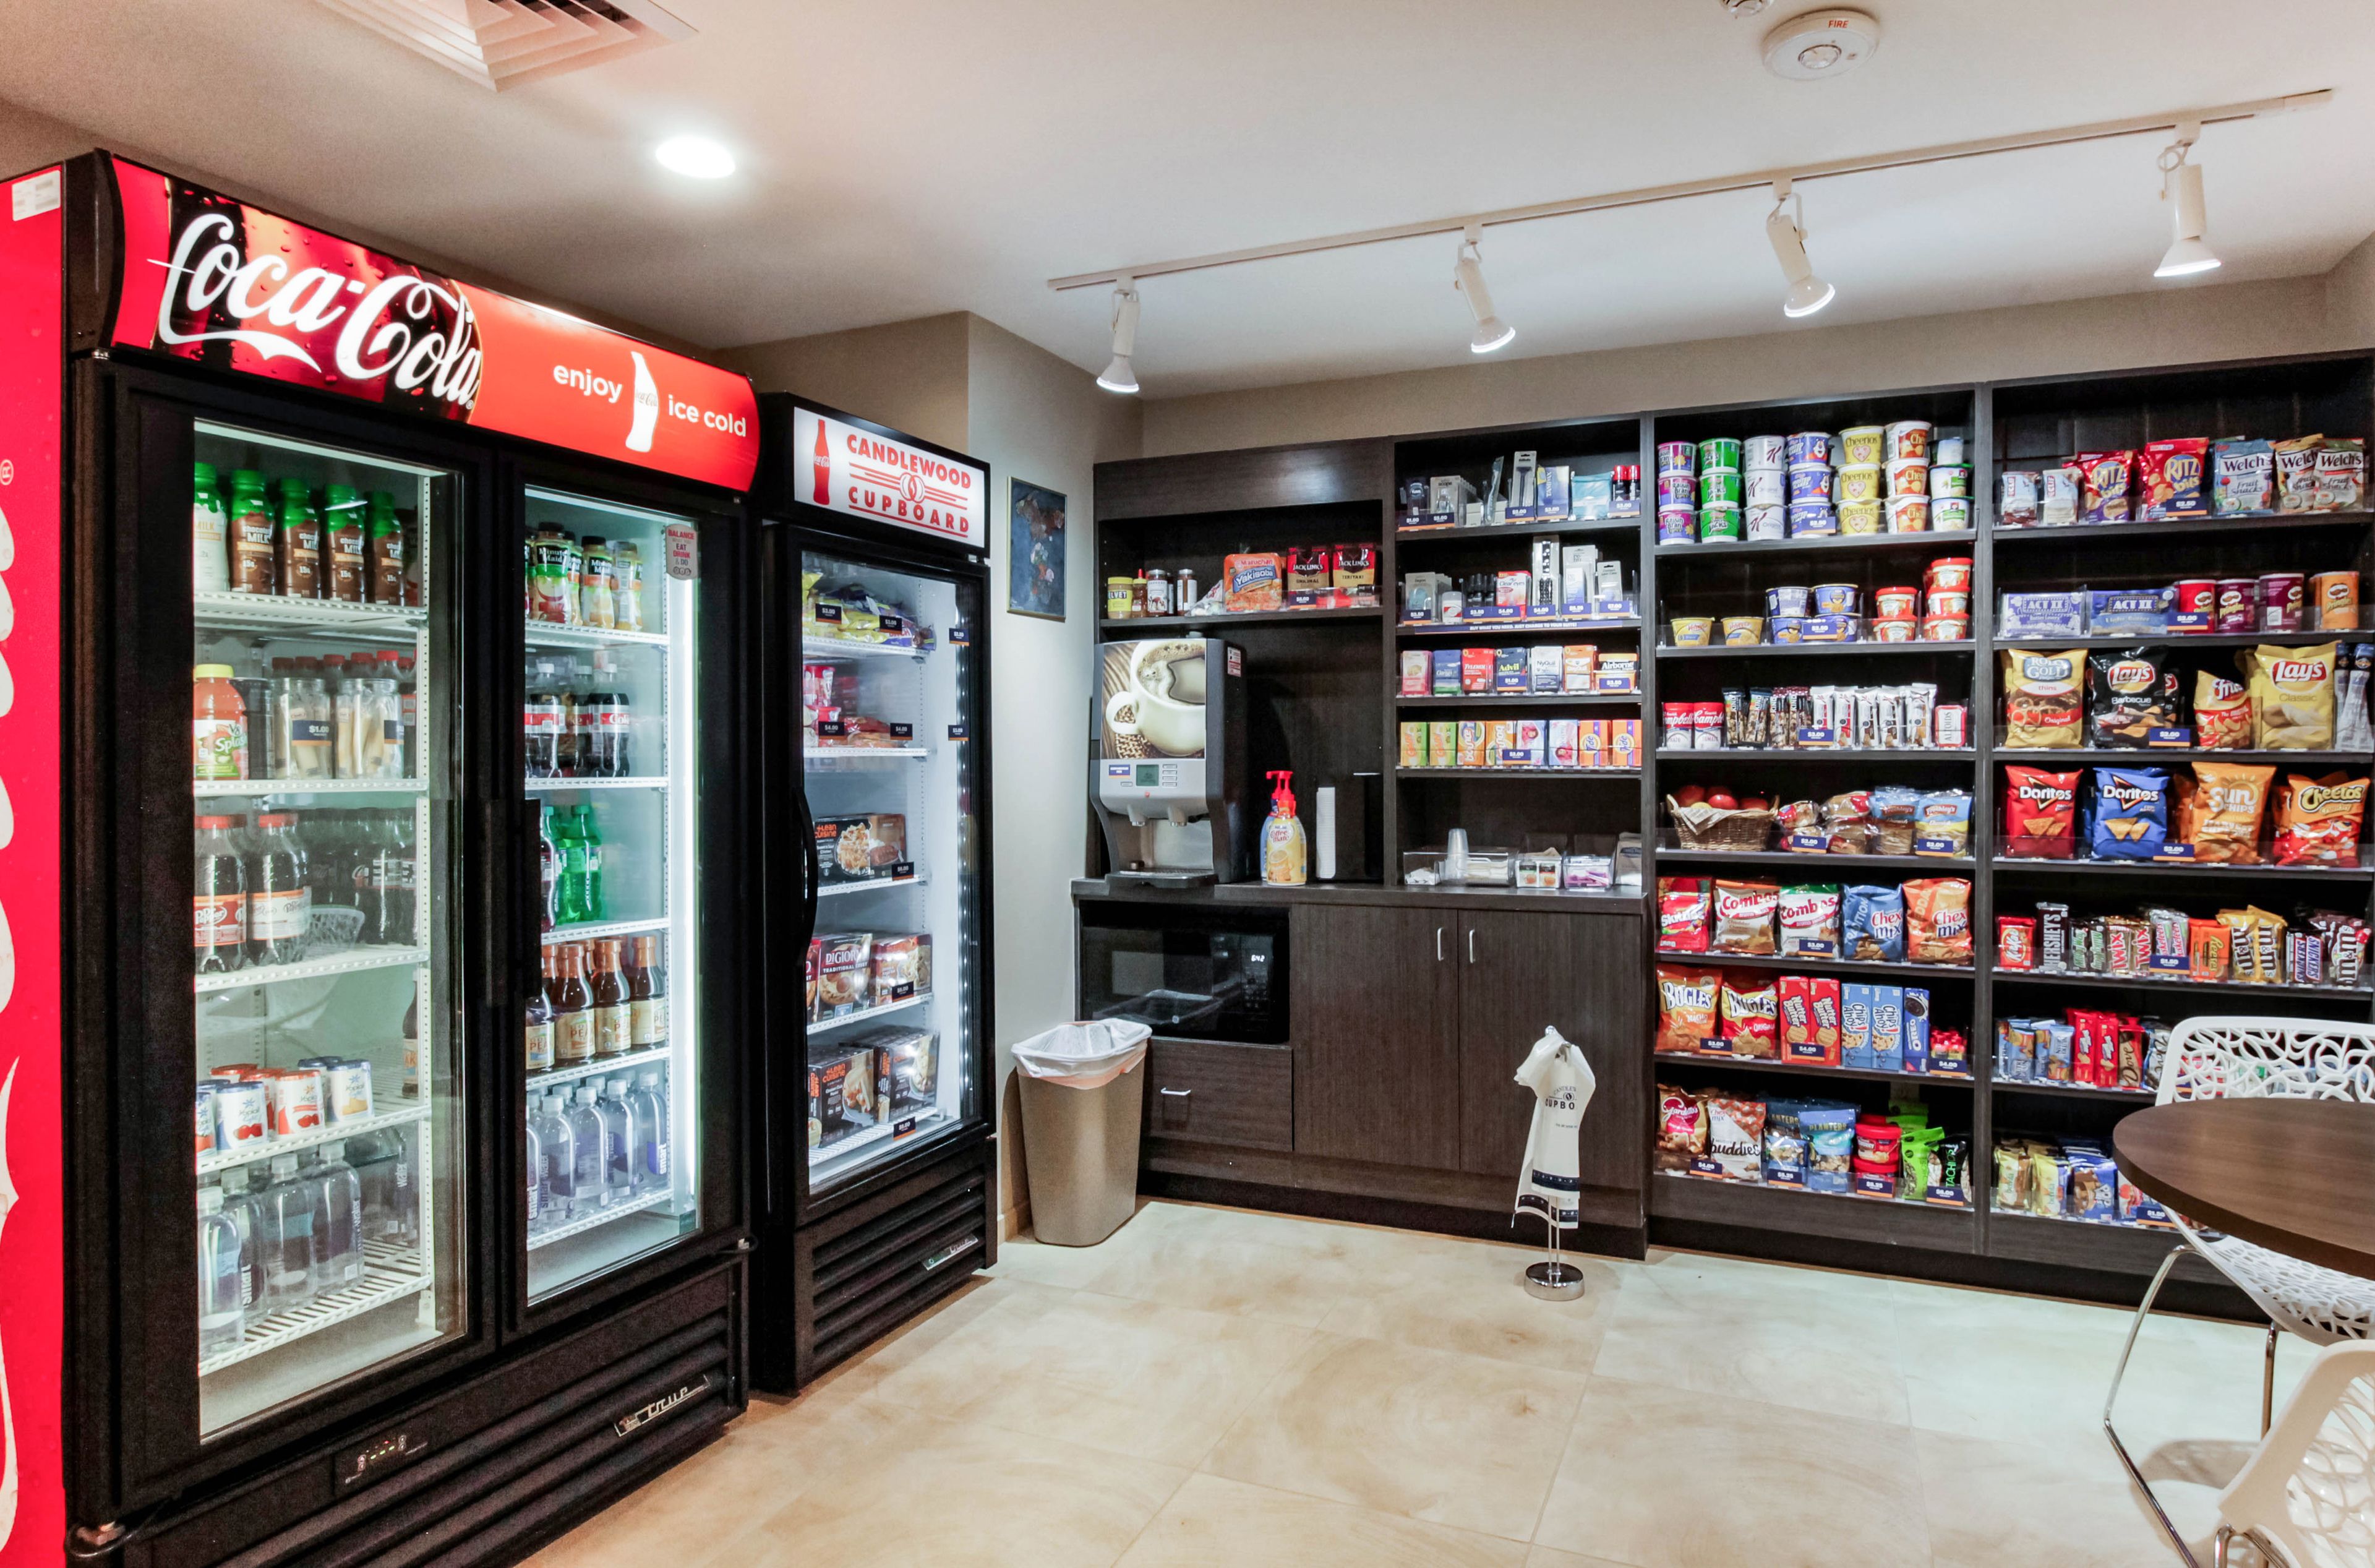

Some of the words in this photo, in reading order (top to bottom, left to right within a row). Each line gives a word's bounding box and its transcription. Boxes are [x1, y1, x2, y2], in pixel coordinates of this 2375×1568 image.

[1828, 20, 1849, 28] FIRE
[147, 213, 482, 405] Coca-Cola
[554, 364, 622, 405] enjoy
[668, 394, 699, 425] ice
[703, 410, 747, 438] cold
[1846, 436, 1878, 447] Cheerios
[847, 434, 971, 489] CANDLEWOOD
[2282, 449, 2317, 469] Welch
[2321, 452, 2362, 468] Welch's
[1841, 472, 1873, 481] Cheerios
[2092, 464, 2126, 486] RITZ
[2165, 458, 2199, 481] RITZ
[849, 486, 969, 533] CUPBOARD
[668, 529, 695, 539] BALANCE
[1236, 568, 1274, 586] Yakisoba
[2027, 600, 2048, 609] ACT
[2051, 600, 2064, 609] II
[2113, 600, 2136, 610] ACT
[2139, 599, 2154, 609] II
[1499, 662, 1520, 672] Advil
[1602, 662, 1635, 670] Airborne
[2026, 664, 2068, 679] GOLD
[2111, 696, 2152, 705] Barbecue
[2279, 693, 2317, 703] Classic
[609, 713, 630, 725] Cok
[2044, 714, 2071, 724] Original
[2019, 786, 2072, 800] Doritos
[2103, 784, 2159, 802] Doritos
[2301, 785, 2364, 812] Cheetos
[1722, 891, 1779, 910] Combos
[1871, 909, 1903, 926] Chex
[1932, 909, 1967, 926] Chex
[826, 949, 862, 965] DIGIORN
[2307, 936, 2321, 980] SNICKERS
[823, 964, 855, 973] TRADITIONAL
[1662, 981, 1713, 1011] BUGLES
[1727, 990, 1777, 1018] BUGLES
[1784, 1000, 1801, 1027] Butter
[1792, 995, 1808, 1024] Nutter
[1813, 1001, 1831, 1029] Butter
[1822, 996, 1838, 1026] Nutter
[1852, 1003, 1867, 1030] Chips
[1883, 1005, 1897, 1031] Chips
[1910, 1019, 1922, 1051] OREO
[1545, 1098, 1575, 1110] CUPBO
[1771, 1114, 1800, 1125] ANTERS
[1711, 1138, 1761, 1157] buddies
